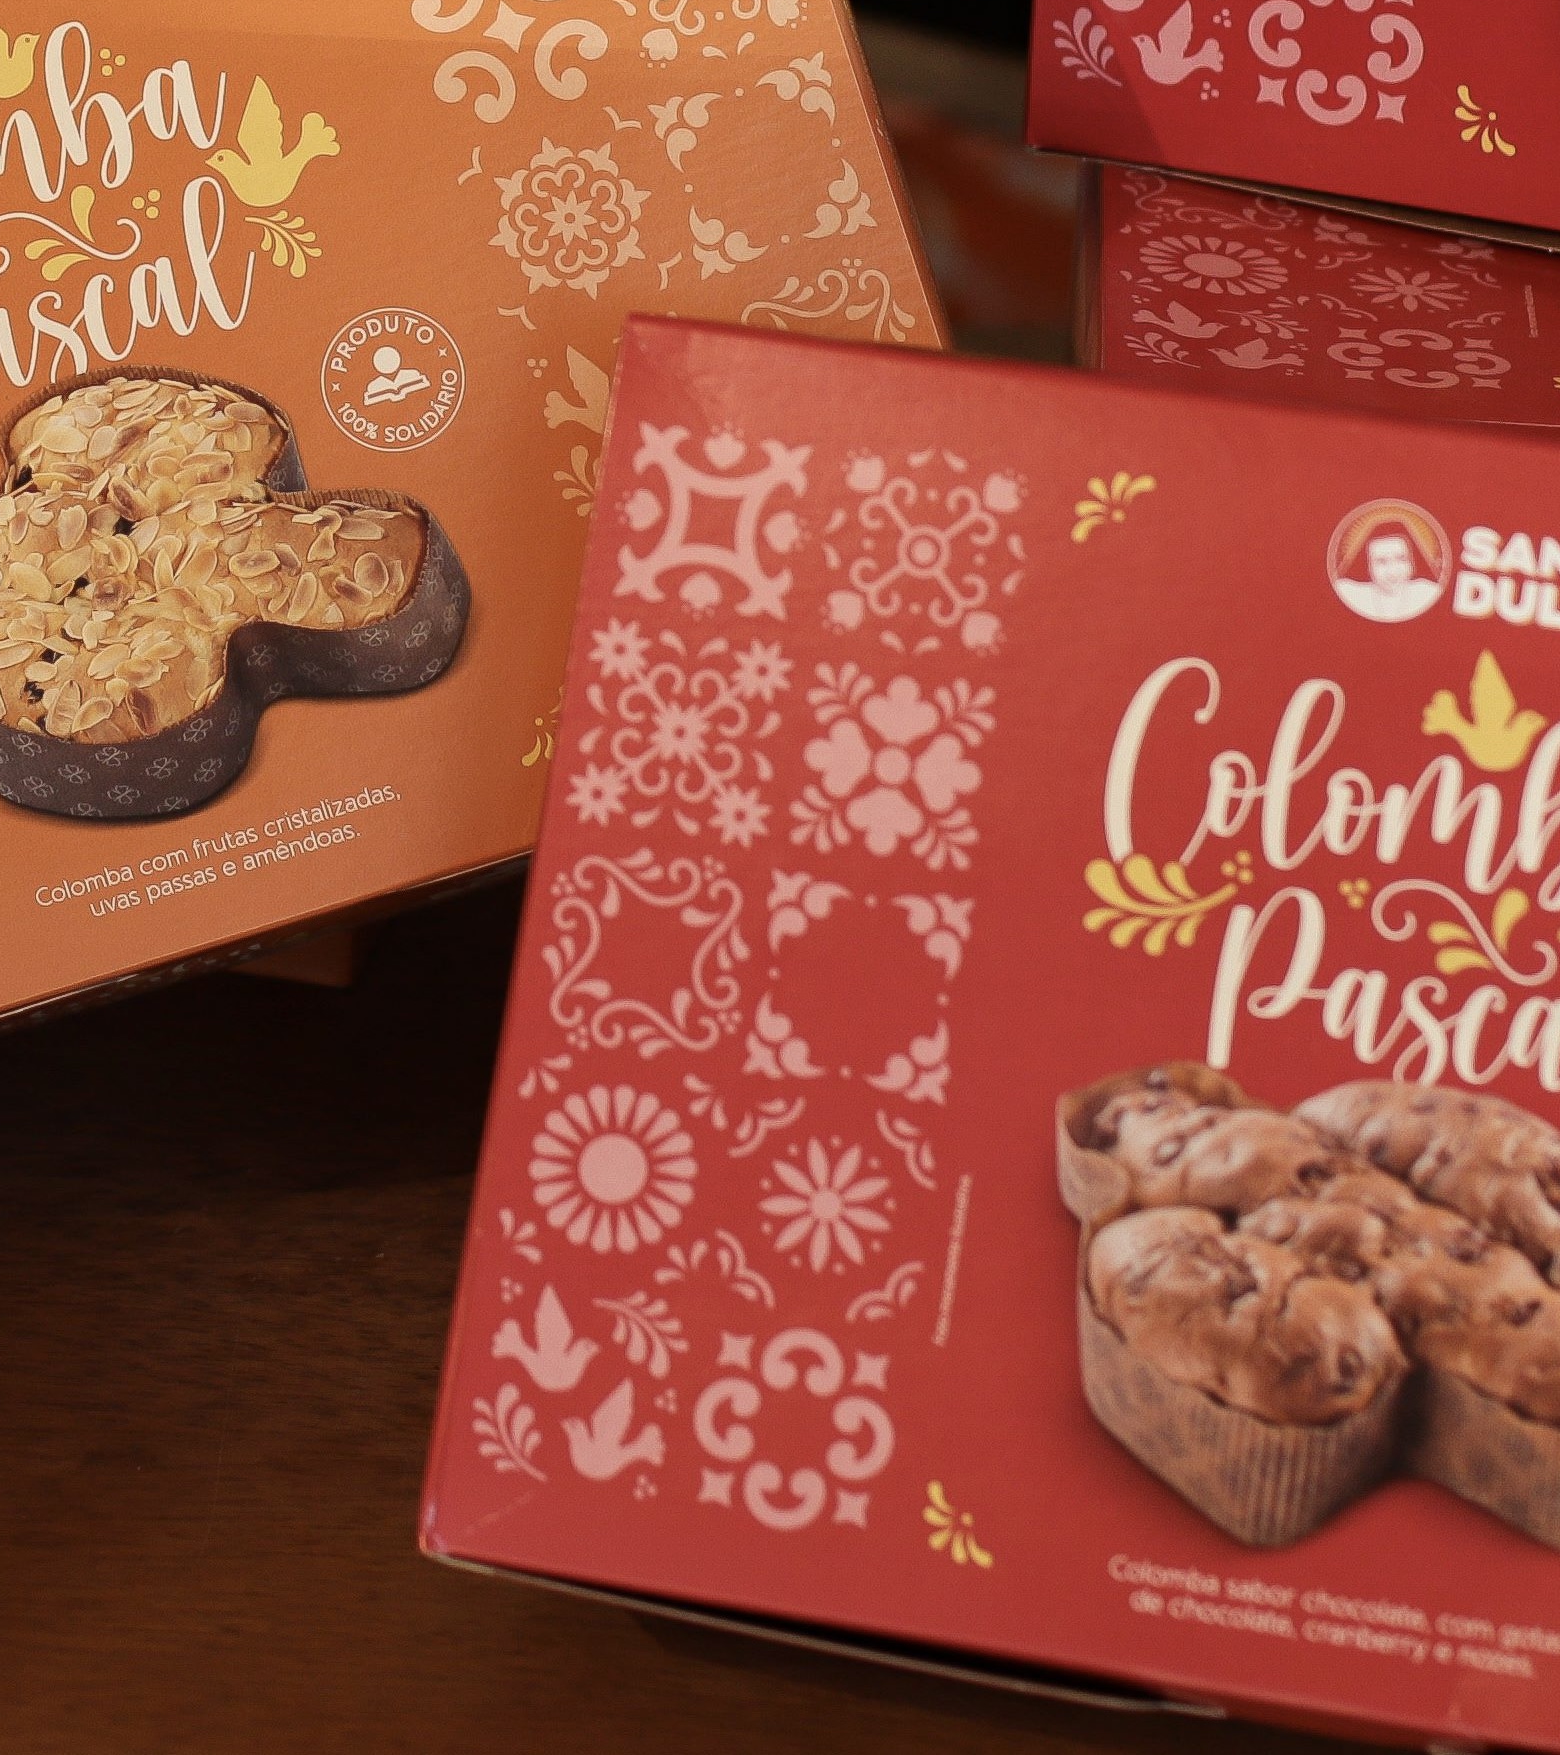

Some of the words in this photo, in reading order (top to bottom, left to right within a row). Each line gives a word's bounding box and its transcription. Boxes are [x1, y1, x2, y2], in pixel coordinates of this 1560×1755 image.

[330, 315, 435, 372] PRODUTO
[338, 403, 378, 440] 100%
[384, 369, 458, 442] SOLIDÁRIO
[35, 865, 134, 907] Colomba
[139, 849, 189, 877] com
[192, 828, 259, 860] frutas
[263, 784, 402, 838] cristalizadas,
[89, 891, 140, 918] uvas
[147, 871, 217, 905] passas
[222, 861, 236, 877] e
[243, 825, 360, 872] amêndoas.
